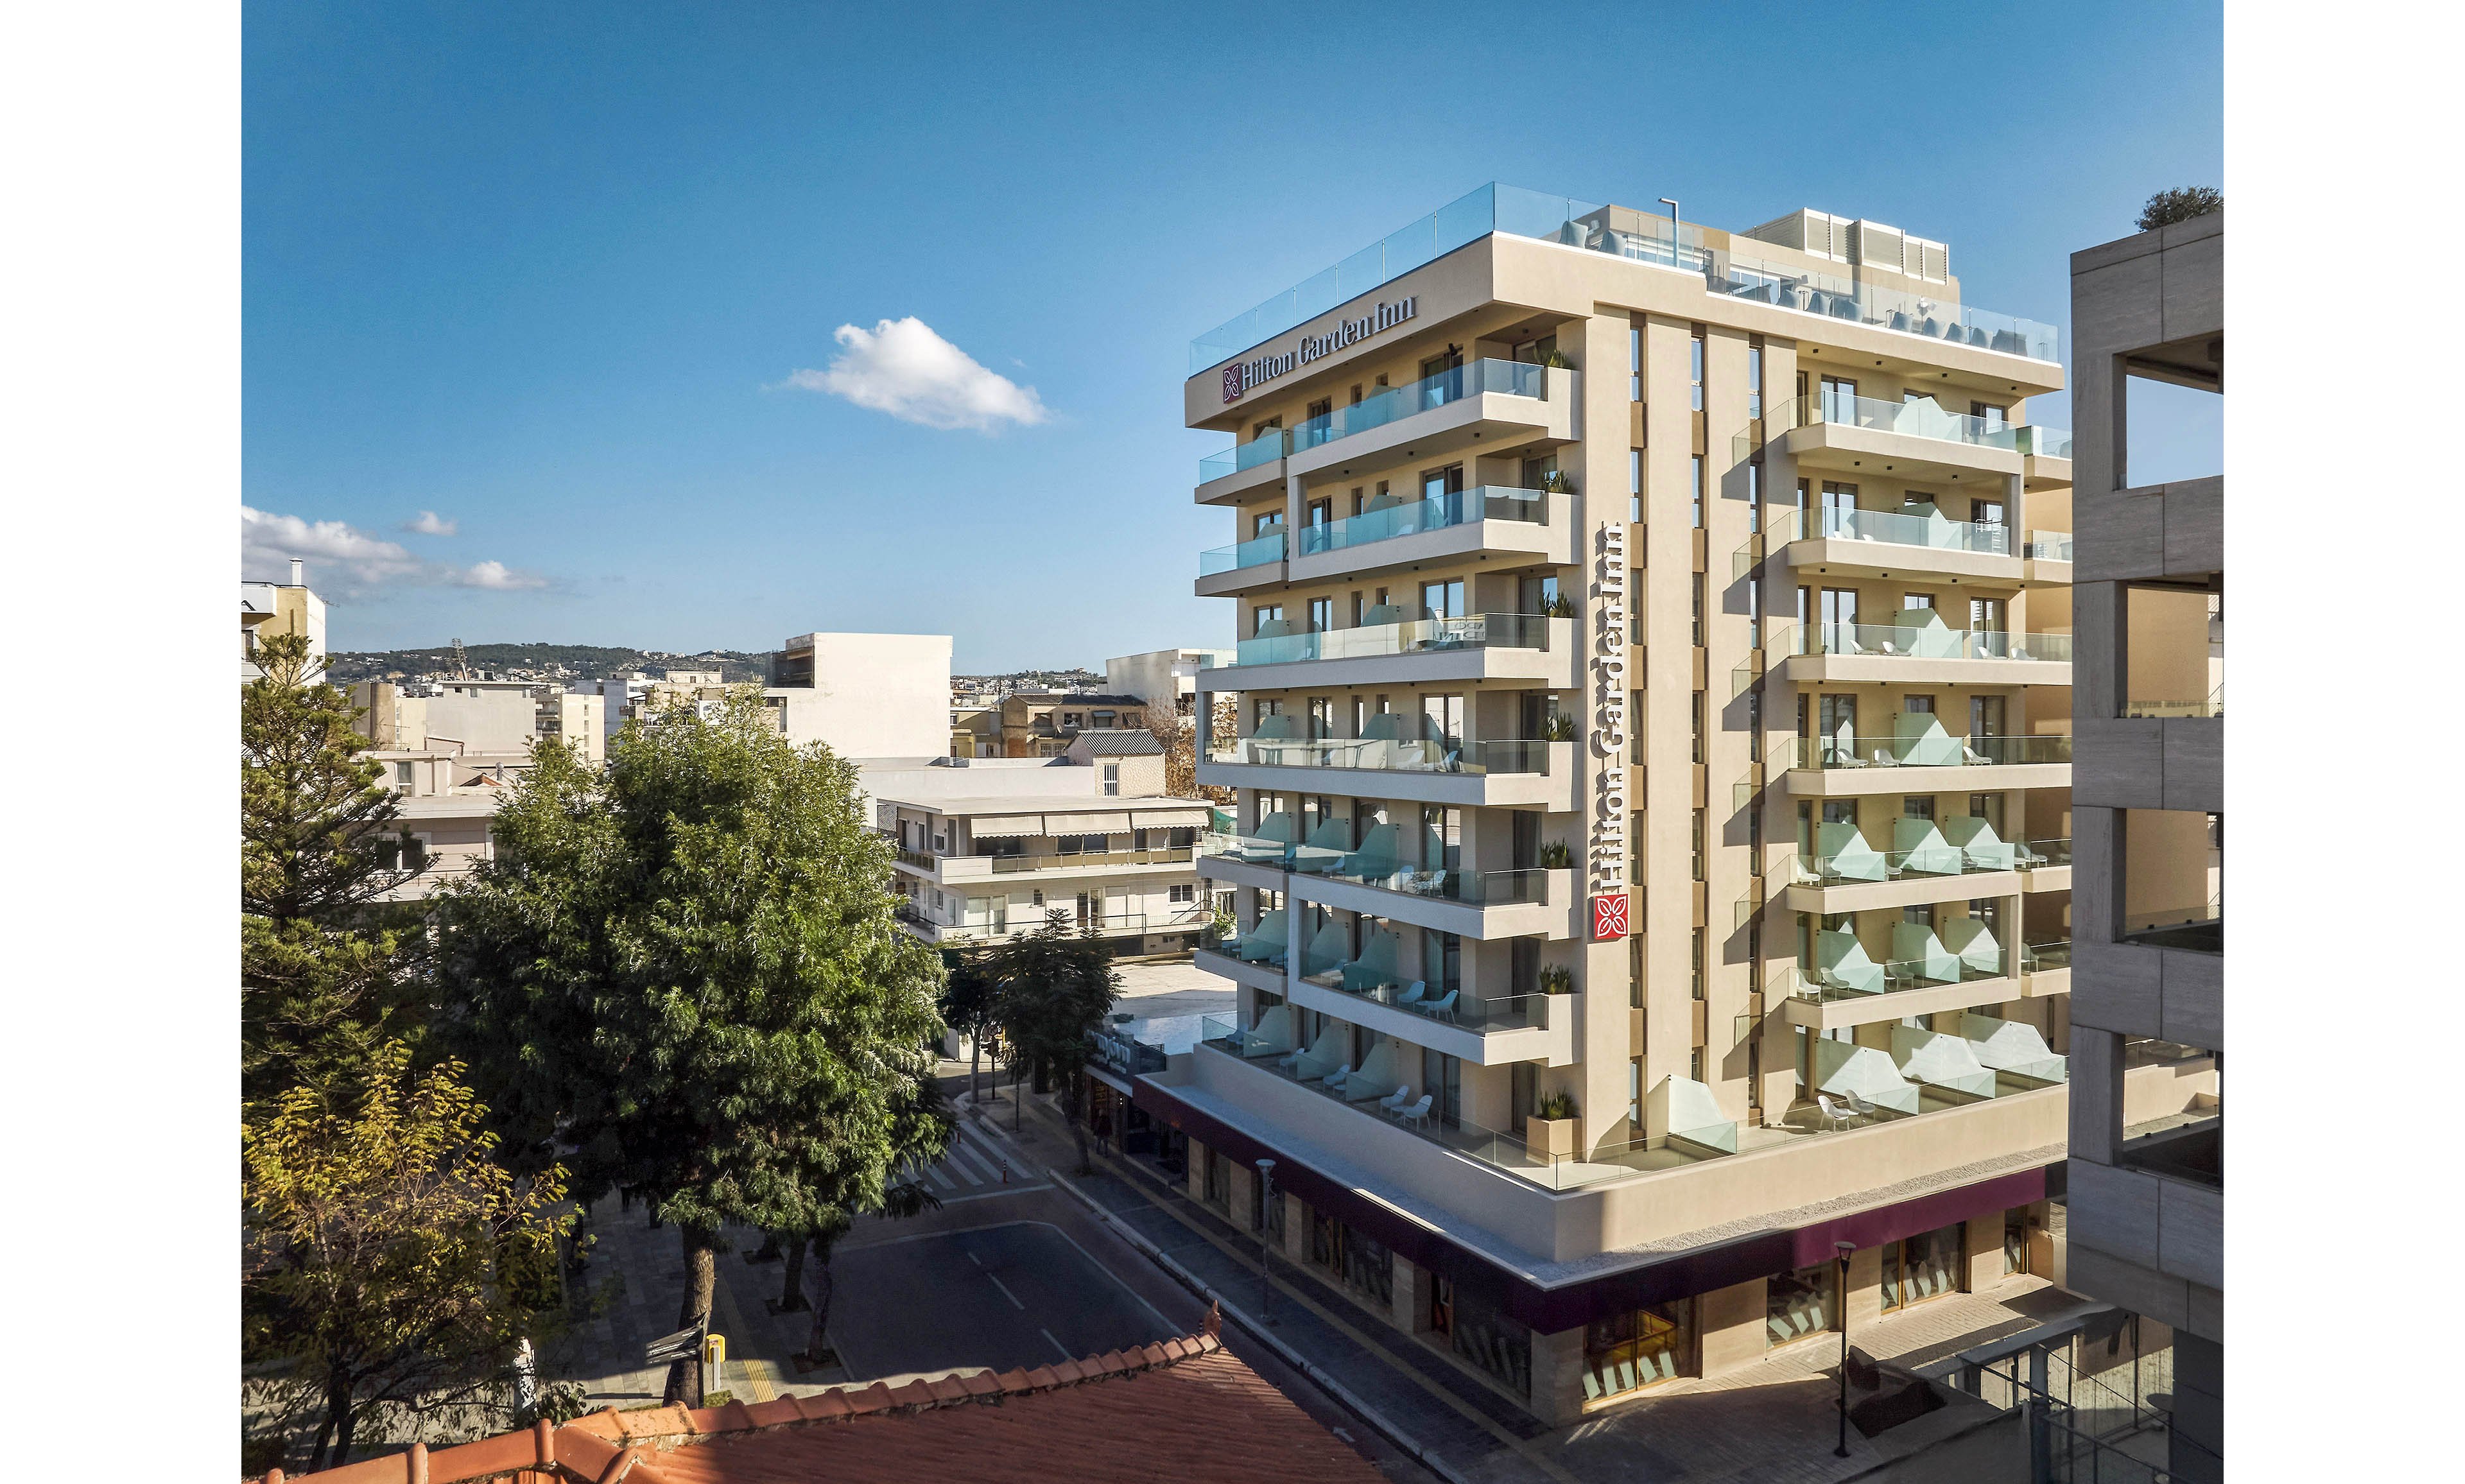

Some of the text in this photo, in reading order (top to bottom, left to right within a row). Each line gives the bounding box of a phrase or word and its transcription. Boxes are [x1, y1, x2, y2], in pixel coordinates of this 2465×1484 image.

[1241, 297, 1414, 390] Hilton Garden Inn
[1600, 524, 1623, 890] Hilton Garden Inn
